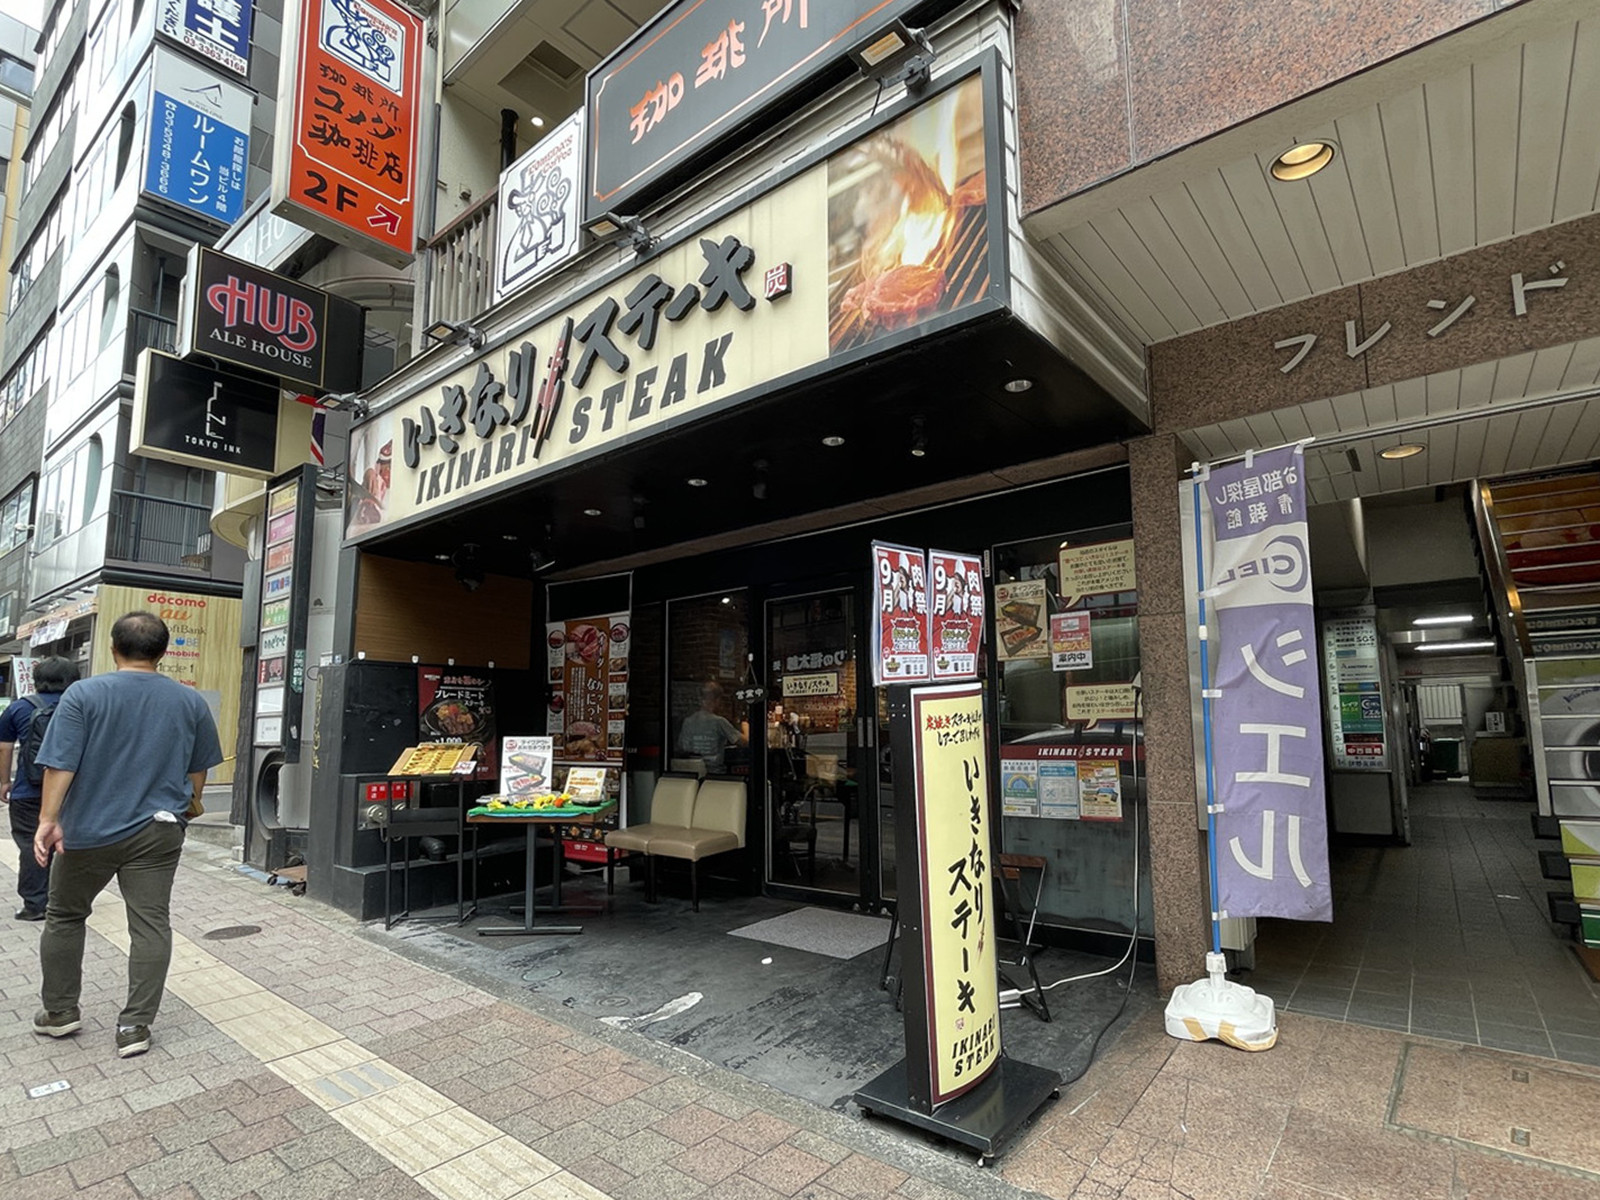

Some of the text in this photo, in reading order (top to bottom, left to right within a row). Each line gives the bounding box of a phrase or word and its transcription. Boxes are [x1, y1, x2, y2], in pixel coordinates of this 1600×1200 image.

[314, 84, 402, 141] コメダ
[188, 114, 216, 204] ルームワン
[307, 113, 403, 185] 珈琲店
[303, 170, 358, 212] 2F
[206, 274, 319, 352] HUB
[1274, 259, 1569, 375] フレンド
[208, 328, 313, 369] ALE HOUSE
[401, 340, 537, 469] いきなり
[570, 234, 756, 390] ステーキ
[185, 434, 242, 454] TOKYO INK
[415, 331, 734, 506] IKINARI STEAK
[147, 593, 207, 609] docomo
[160, 608, 193, 621] au
[168, 624, 207, 636] oftBank
[1038, 747, 1124, 757] IKINARI STEAK
[963, 756, 986, 925] いきなり
[948, 857, 976, 1014] ステーキ
[951, 1013, 996, 1060] IKINARI
[953, 1033, 995, 1078] STEAK
